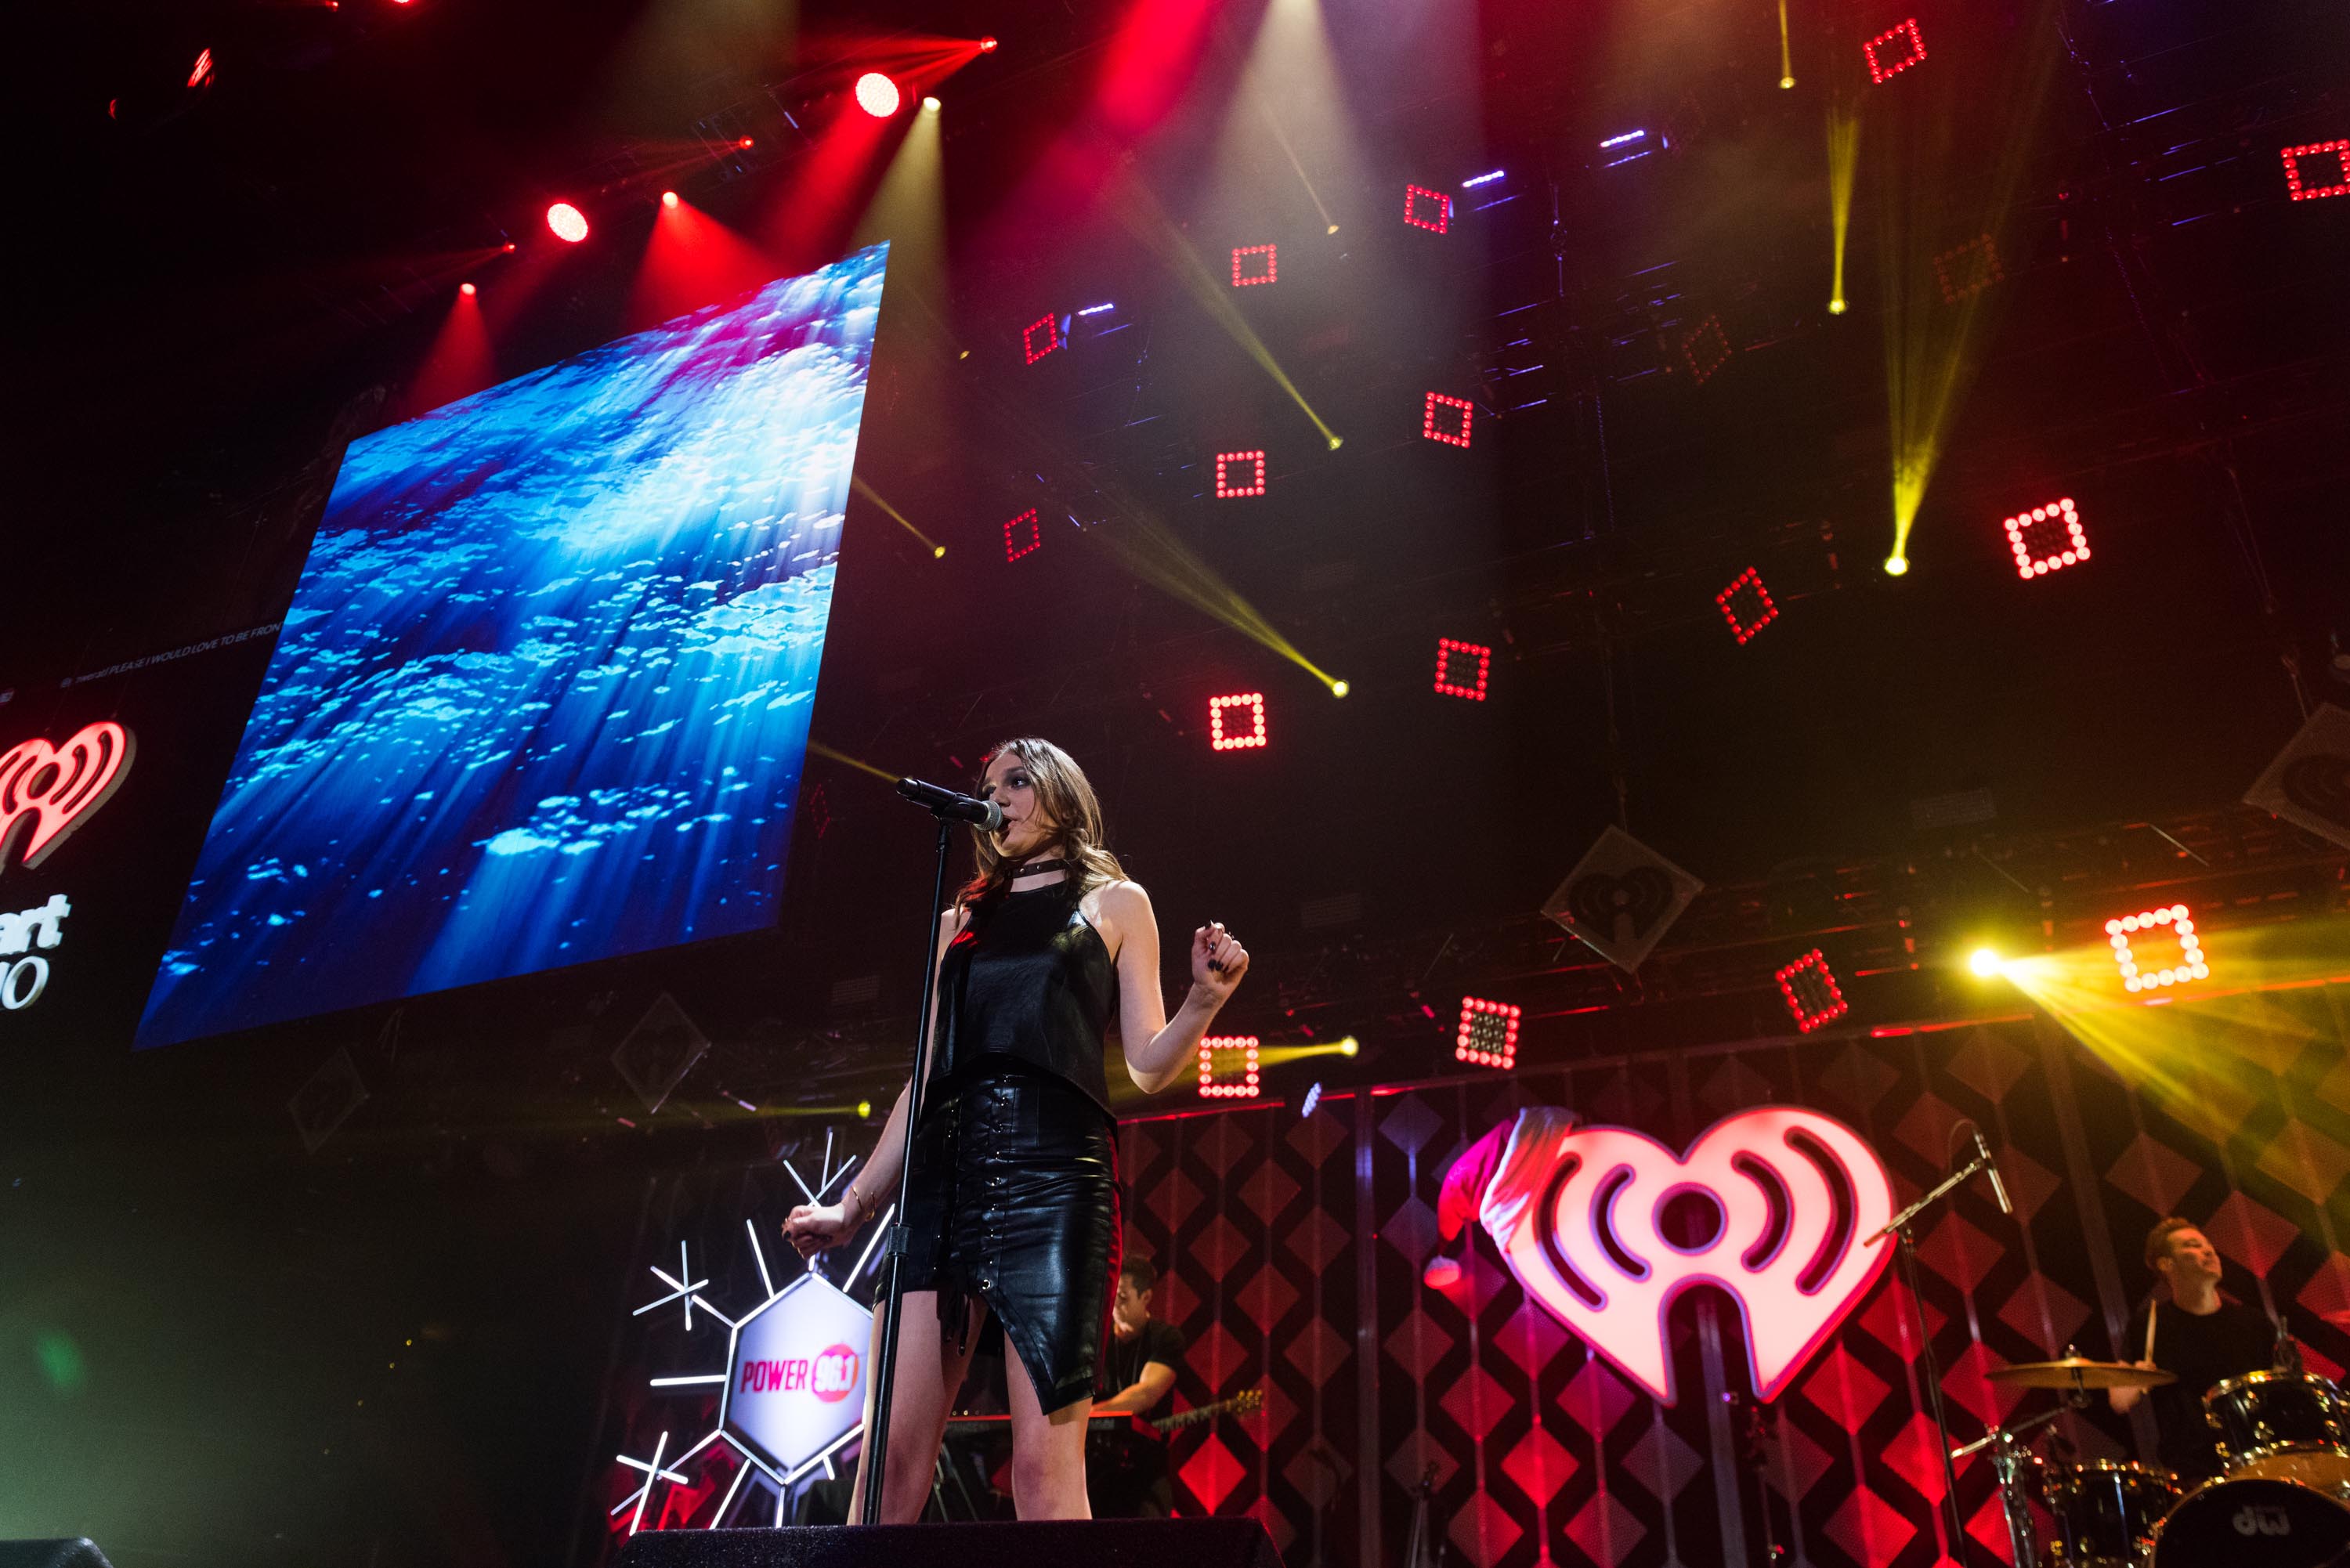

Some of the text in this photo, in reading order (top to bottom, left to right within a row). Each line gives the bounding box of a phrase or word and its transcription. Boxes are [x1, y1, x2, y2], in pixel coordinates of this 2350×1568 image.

[109, 657, 146, 674] PLEASE
[151, 645, 190, 664] WOULD
[192, 638, 219, 654] LOVE
[220, 634, 235, 646] TO
[235, 630, 250, 642] BE
[740, 1360, 808, 1393] POWER
